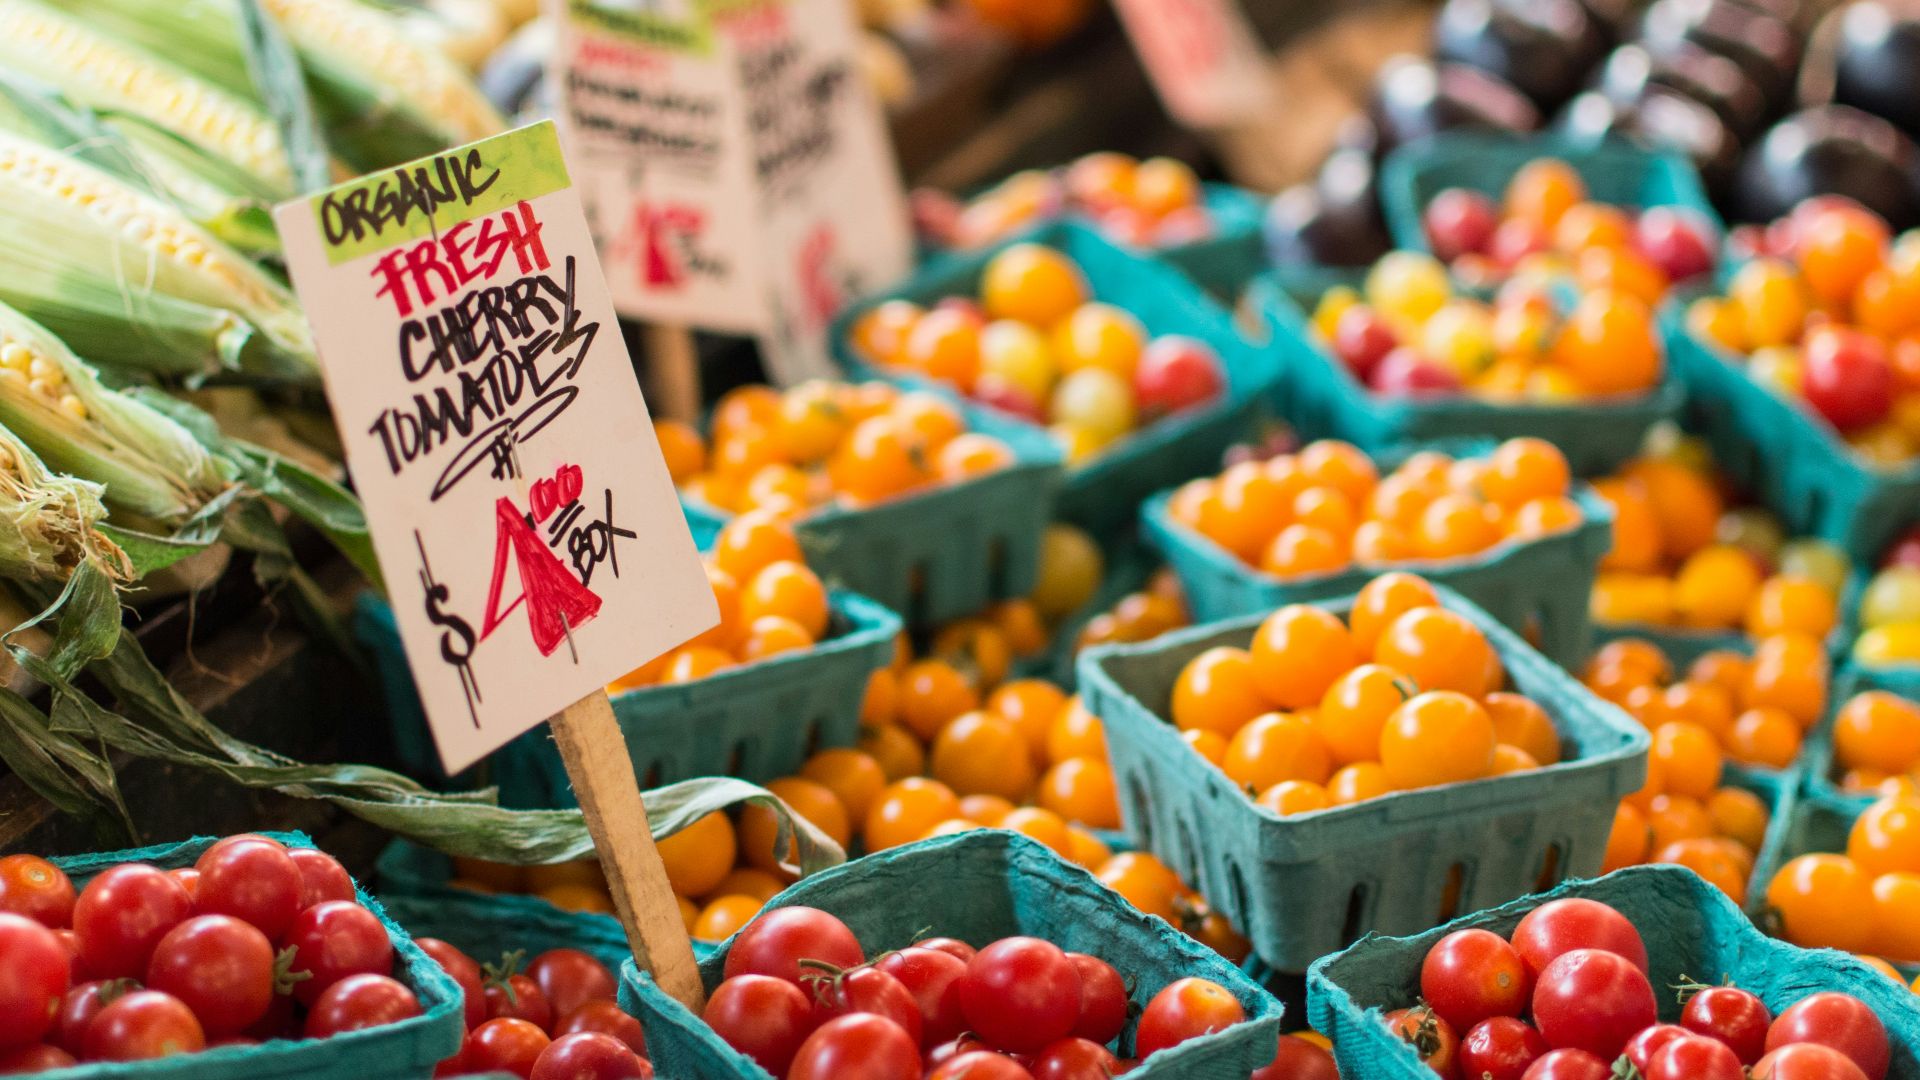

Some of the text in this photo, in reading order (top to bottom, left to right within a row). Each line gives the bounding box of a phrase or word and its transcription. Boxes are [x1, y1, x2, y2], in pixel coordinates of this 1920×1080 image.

[320, 148, 500, 246] ORGANIC
[369, 200, 551, 318] FRESH
[399, 255, 576, 381] CHERRY
[368, 309, 600, 475] TOMATOES
[567, 487, 638, 588] BOX
